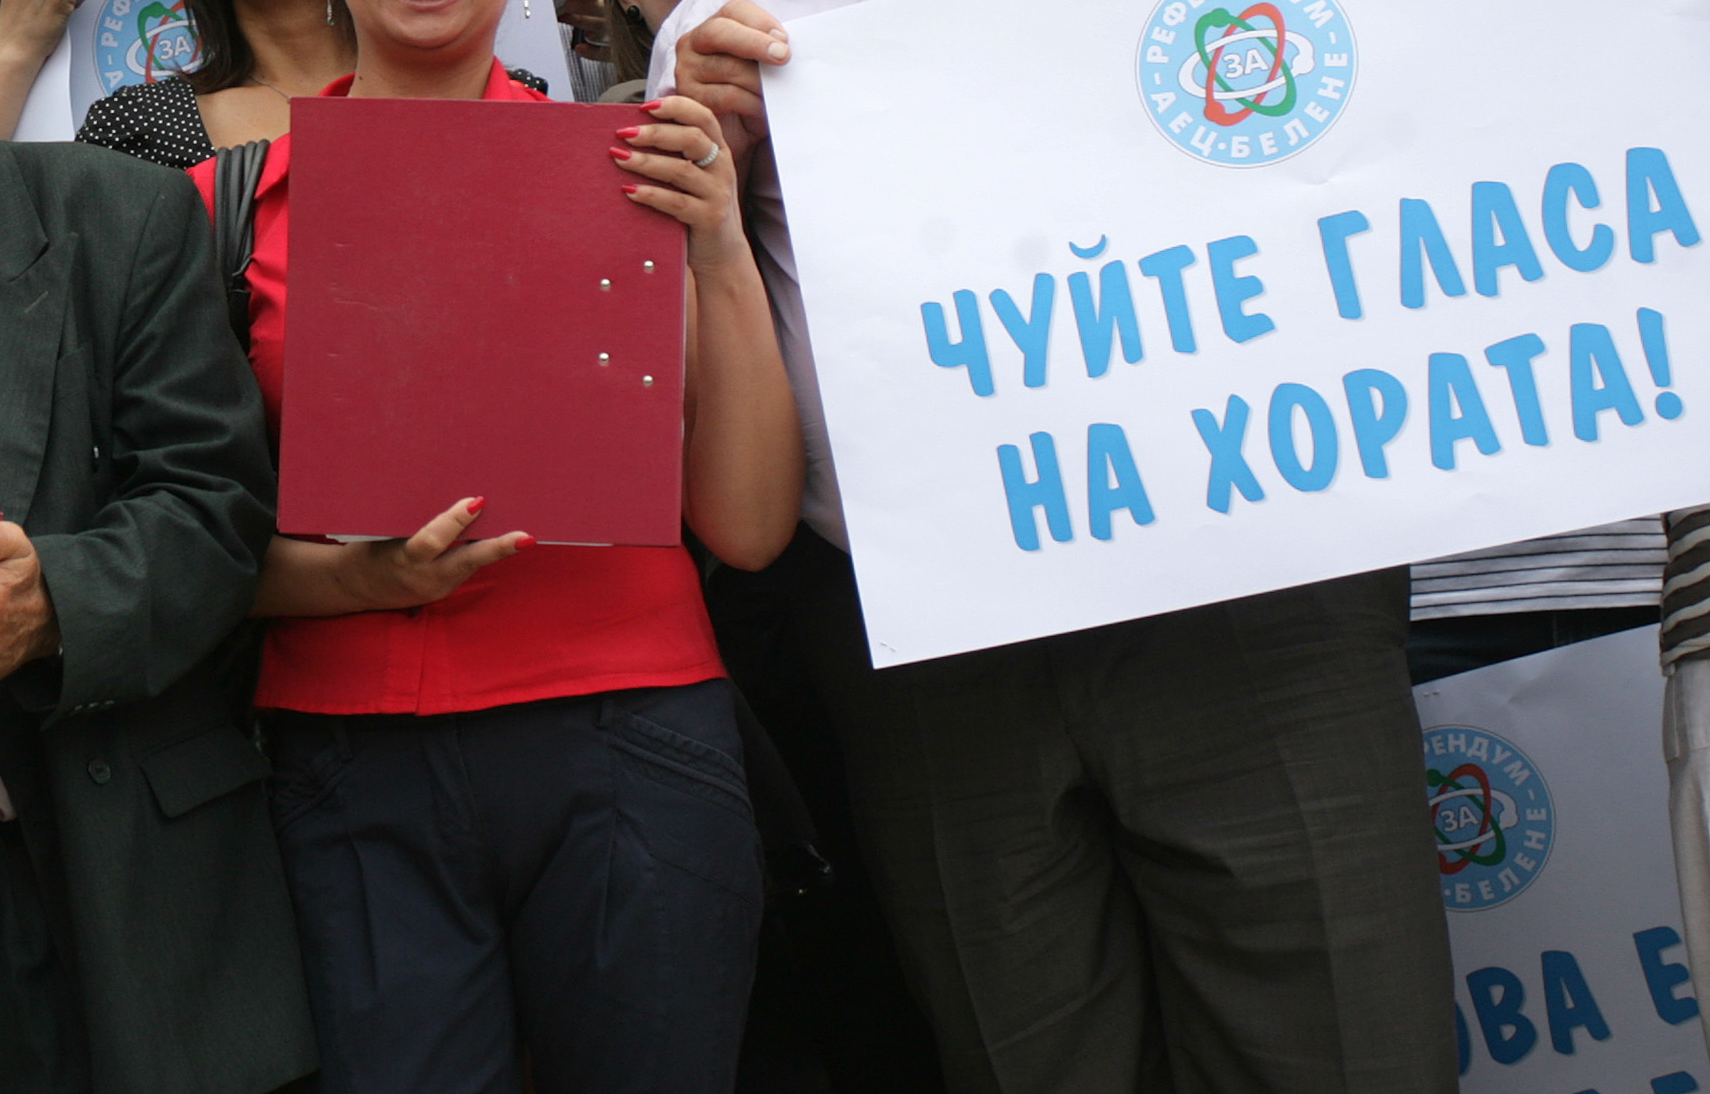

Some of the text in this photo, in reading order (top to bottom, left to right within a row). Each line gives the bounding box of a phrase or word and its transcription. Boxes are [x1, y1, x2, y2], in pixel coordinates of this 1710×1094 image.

[158, 35, 192, 61] ЗА
[1223, 48, 1270, 79] ЗА
[920, 146, 1701, 398] ЧУЙТЕ ГЛАСА
[996, 306, 1684, 552] НА ХОРАТА!
[1441, 806, 1480, 832] ЗА
